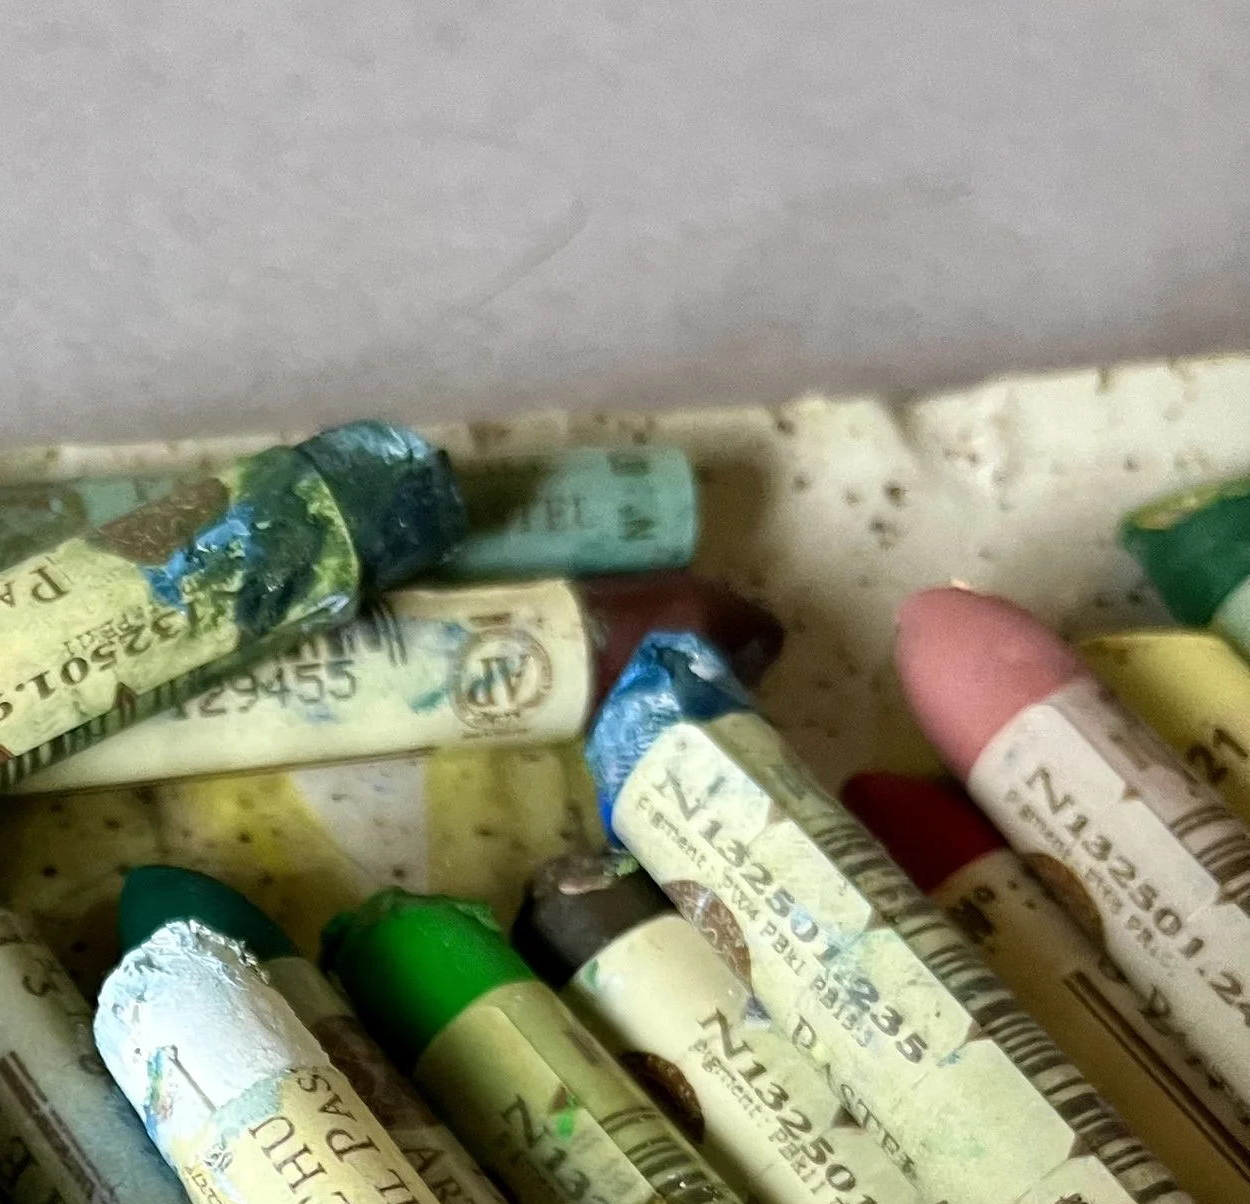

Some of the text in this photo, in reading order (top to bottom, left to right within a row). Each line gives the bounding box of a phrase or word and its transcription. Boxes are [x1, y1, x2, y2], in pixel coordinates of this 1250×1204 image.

[652, 770, 928, 1065] N132501.235
[1025, 766, 1250, 1026] N132501.2
[298, 1070, 381, 1163] PAS
